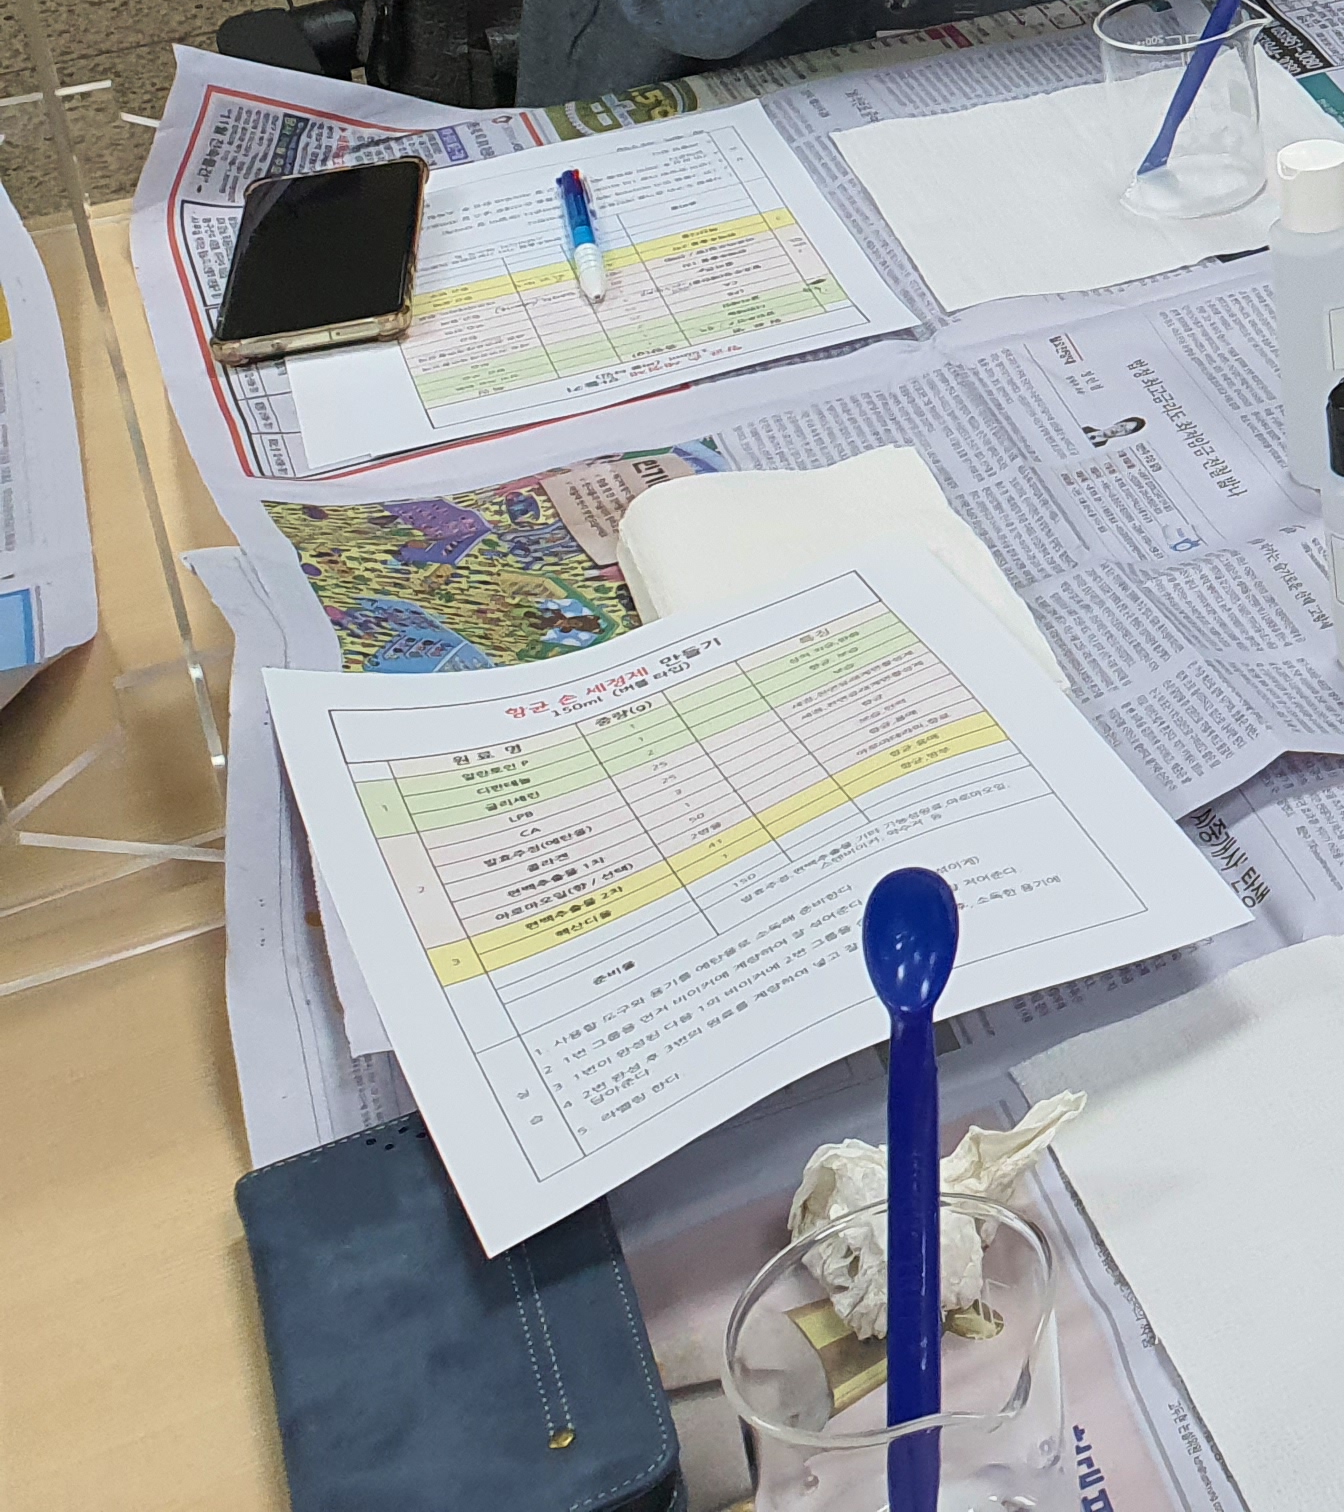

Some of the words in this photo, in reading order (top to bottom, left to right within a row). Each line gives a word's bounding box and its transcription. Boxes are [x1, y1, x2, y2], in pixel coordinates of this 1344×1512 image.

[505, 700, 549, 719] 항균
[559, 694, 578, 706] 손
[586, 667, 649, 695] 세정제
[659, 638, 722, 666] 만들기
[551, 695, 603, 717] 150ml
[652, 662, 691, 680] 타입)
[508, 811, 534, 823] LPB
[519, 827, 540, 837] CA
[732, 873, 756, 888] 150
[1230, 865, 1271, 909] 탄생
[553, 1022, 597, 1046] 사용할
[601, 996, 645, 1022] 도구와
[650, 971, 692, 998] 용기를
[799, 885, 853, 917] 준비한다
[563, 1047, 588, 1064] 1번
[592, 1023, 635, 1048] 그룹을
[640, 1004, 669, 1023] 먼저
[664, 1012, 693, 1031] 다음
[651, 1072, 681, 1092] 한다
